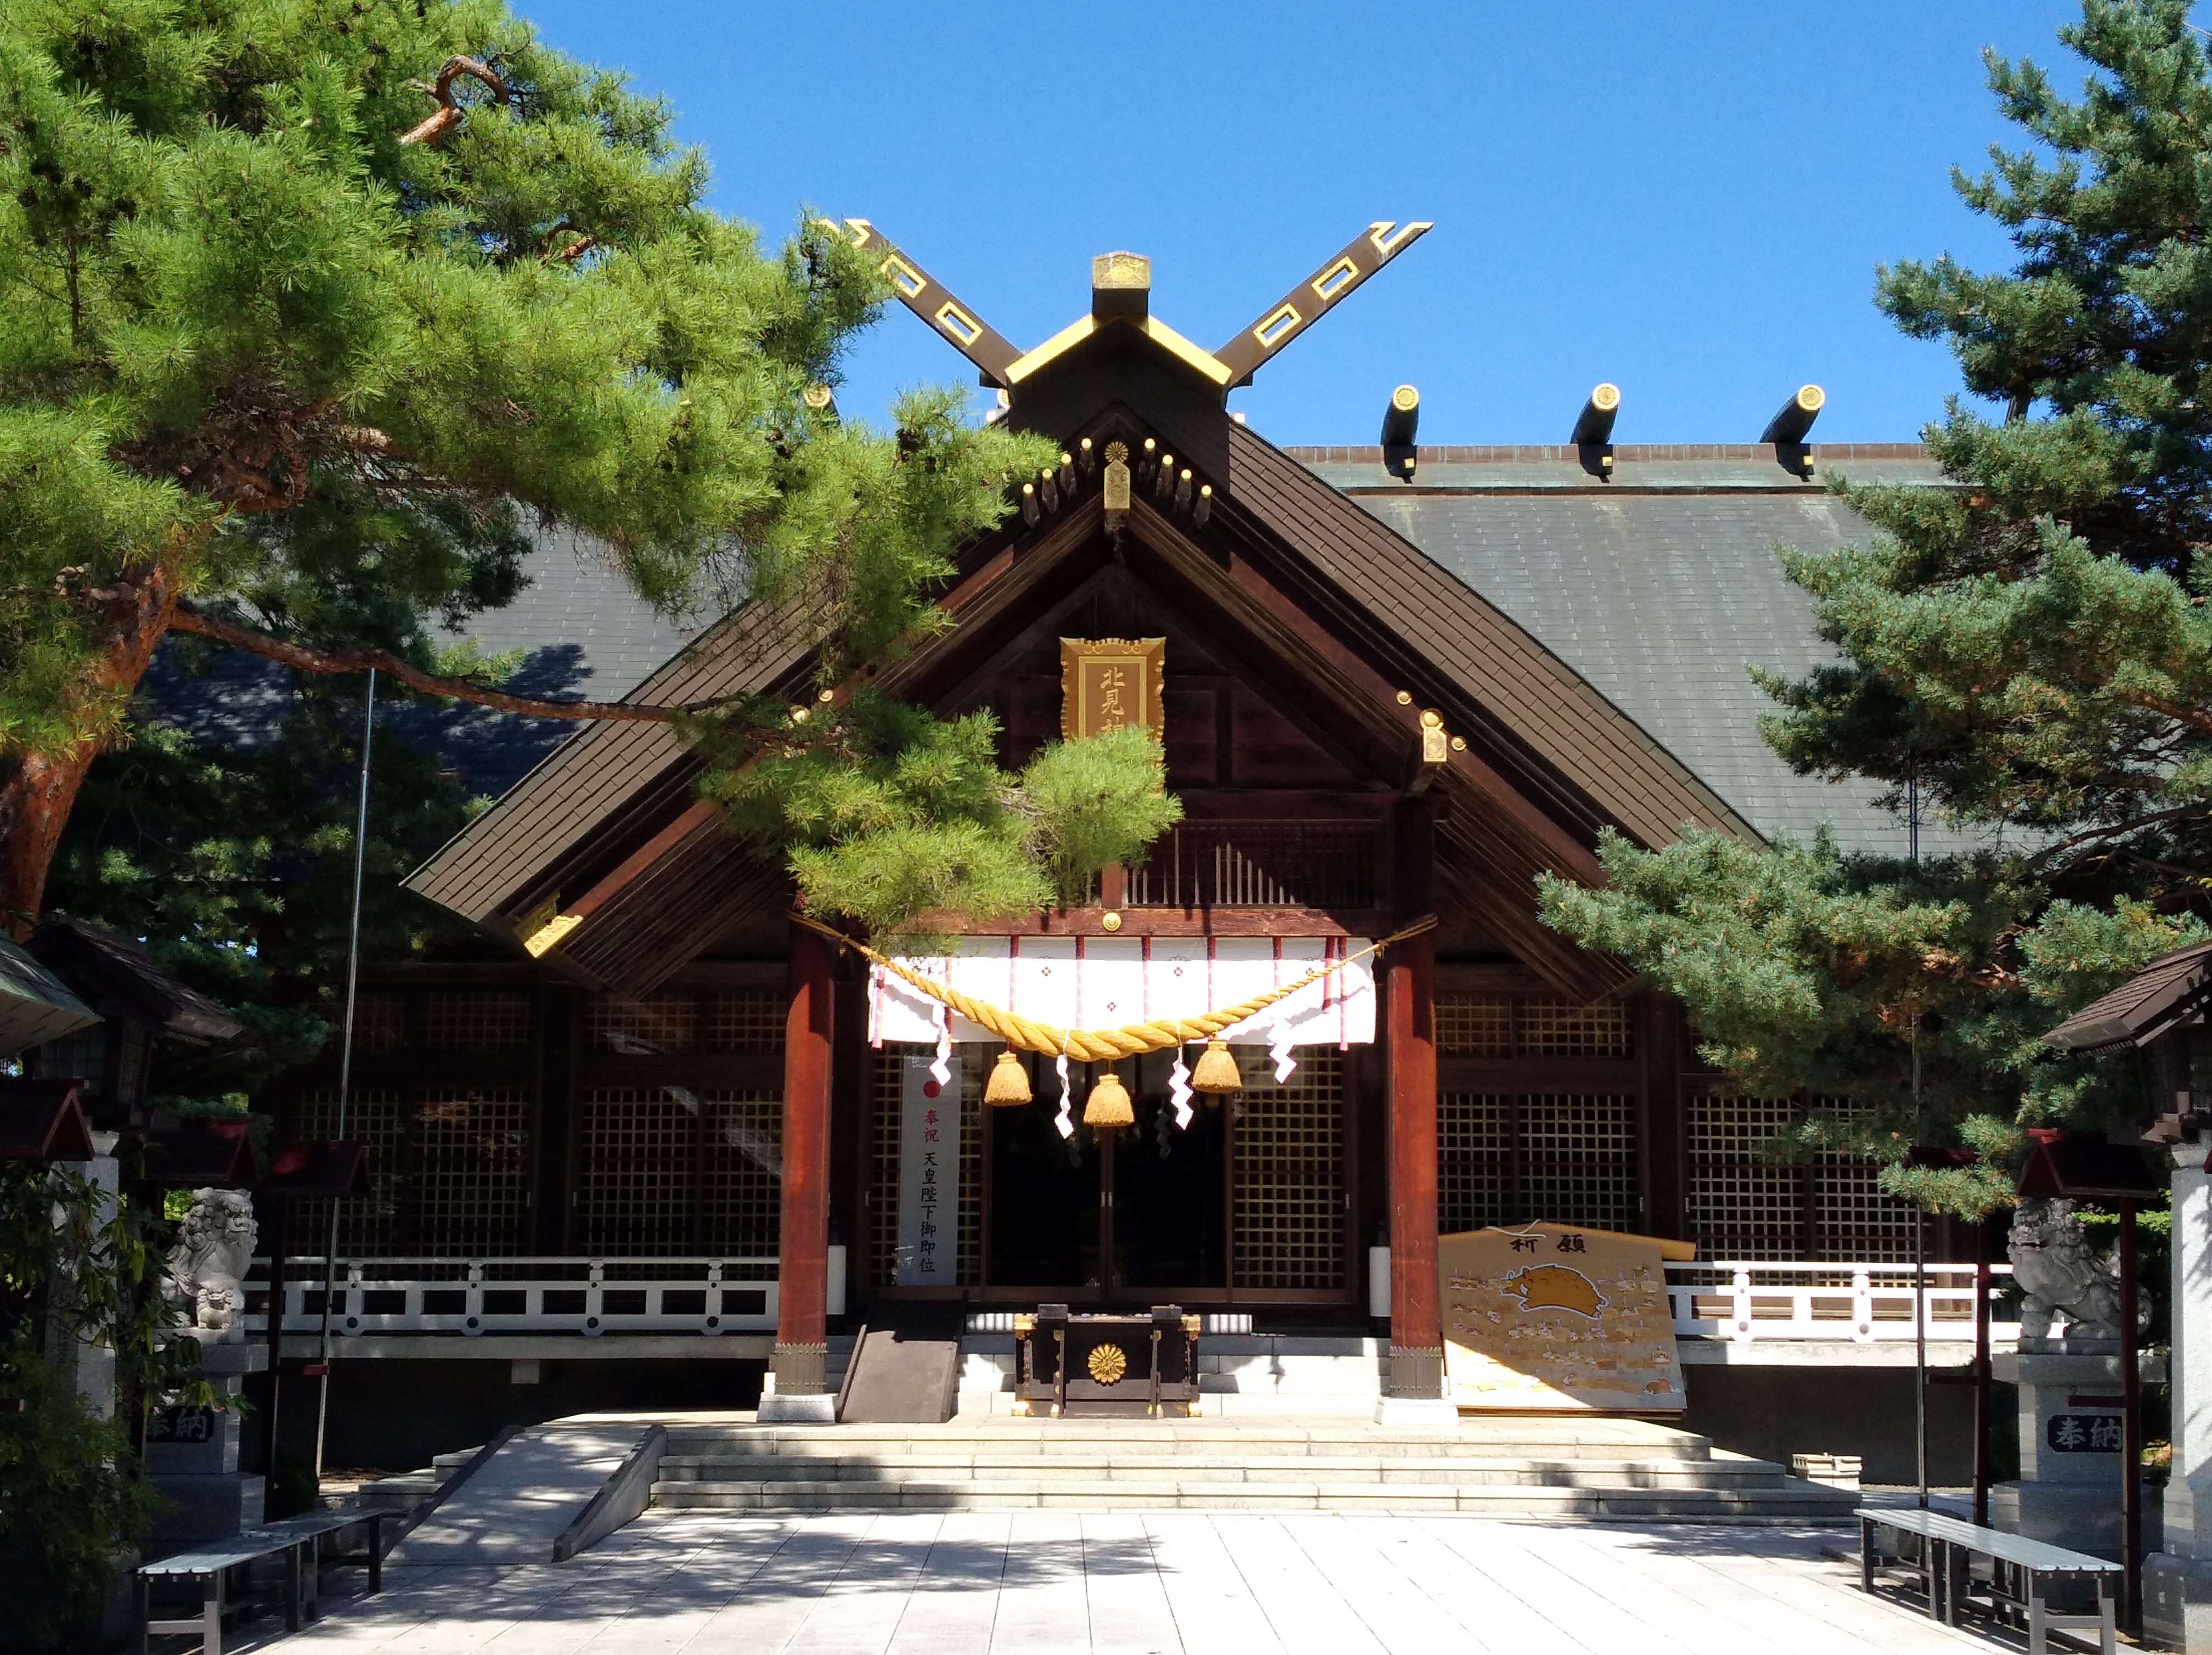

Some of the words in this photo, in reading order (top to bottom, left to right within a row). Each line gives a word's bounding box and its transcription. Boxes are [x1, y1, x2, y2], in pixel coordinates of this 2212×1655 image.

[923, 1109, 939, 1142] 奉祝
[919, 1152, 938, 1273] 天皇陛下御即位
[1510, 1234, 1587, 1254] 祈願
[2055, 1416, 2123, 1450] 奉納
